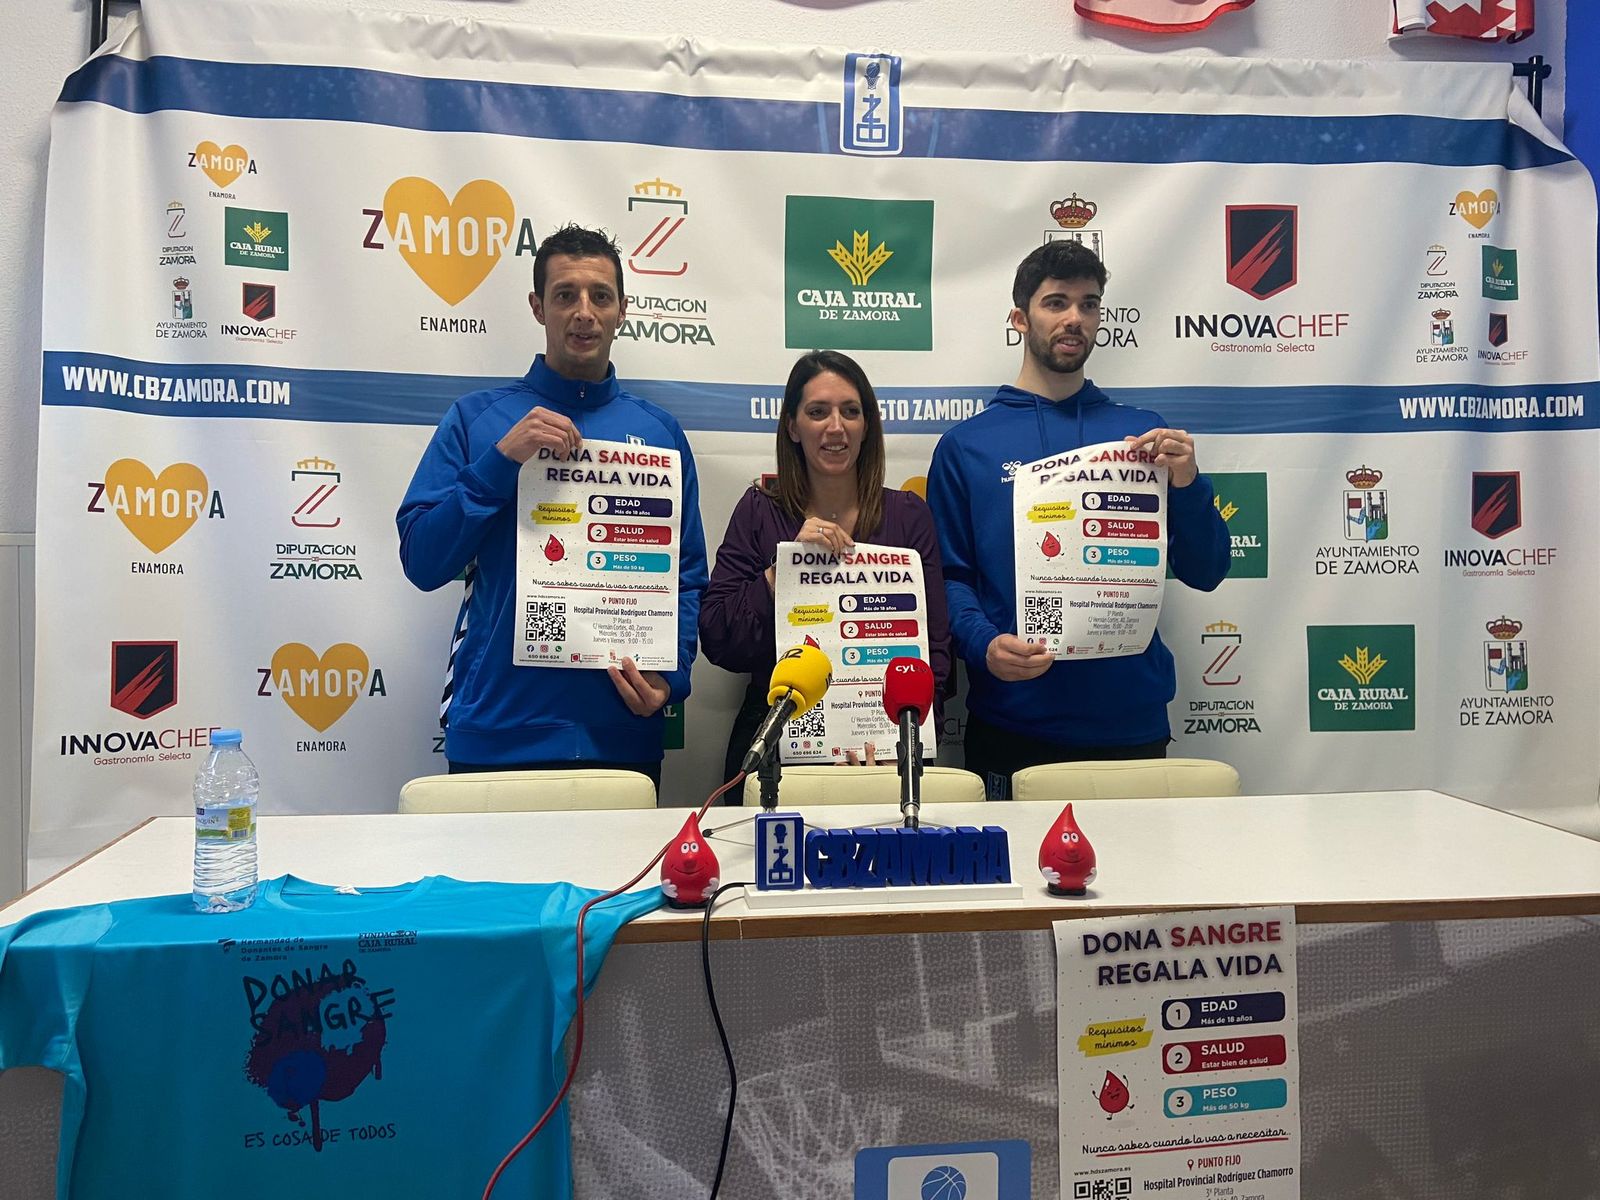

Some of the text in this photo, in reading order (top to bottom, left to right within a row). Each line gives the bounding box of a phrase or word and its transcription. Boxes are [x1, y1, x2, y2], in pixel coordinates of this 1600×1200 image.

[188, 152, 257, 174] ZAMORA
[209, 191, 236, 200] ENAMORA
[1449, 200, 1500, 215] ZAMORA
[362, 208, 538, 256] ZAMORA
[230, 242, 284, 254] CAJA RURAL
[159, 256, 196, 265] ZAMORA
[797, 289, 921, 309] CAJA RURAL
[1418, 290, 1458, 299] ZAMORA
[627, 295, 706, 313] PUTACION
[819, 309, 900, 321] DE ZAMORA
[156, 321, 207, 330] AYUNTAMIENTO
[221, 324, 297, 340] INNOVACHEF
[420, 316, 487, 333] ENAMORA
[1175, 313, 1350, 339] INNOVACHEF
[156, 329, 208, 338] DE ZAMORA
[612, 322, 715, 346] AMORA
[1276, 342, 1315, 352] Selecta
[1416, 353, 1468, 363] DE ZAMORA
[62, 366, 291, 405] WWW.CBZAMORA.COM
[751, 398, 784, 420] CLU
[912, 399, 985, 421] ZAMORA
[1400, 395, 1584, 419] WWW.CBZAMORA.COM
[599, 450, 671, 468] SANGRE
[1032, 454, 1081, 473] DONA
[547, 468, 672, 487] REGALA VIDA
[1118, 469, 1158, 483] VIDA
[87, 482, 225, 519] ZAMORA
[792, 553, 911, 565] DONA SANGRE
[1316, 545, 1420, 558] AYUNTAMIENTO
[1444, 548, 1557, 566] INNOVACHEF
[131, 562, 184, 575] ENAMORA
[270, 563, 362, 580] ZAMORA
[1316, 559, 1420, 574] DE ZAMORA
[800, 572, 913, 584] REGALA VIDA
[574, 606, 594, 614] Hospital
[595, 607, 619, 616] Provincial
[257, 668, 386, 697] ZAMORA
[1318, 687, 1408, 700] CAJA RURAL
[1352, 702, 1393, 710] ZAMORA
[1460, 696, 1554, 709] AYUNTAMIENTO
[1460, 710, 1554, 726] DE ZAMORA
[1184, 718, 1261, 734] ZAMORA
[297, 741, 346, 752] ENAMORA
[158, 752, 191, 762] Selecta
[1083, 921, 1281, 955] DONA SANGRE
[1098, 953, 1282, 986] REGALA VIDA
[243, 959, 366, 1014] DONAR
[1202, 1000, 1237, 1012] EDAD
[1176, 1009, 1180, 1020] 1
[1088, 1025, 1144, 1037] Requisitos
[1202, 1042, 1244, 1055] SALUD
[1175, 1052, 1183, 1064] 2
[1203, 1087, 1237, 1099] PESO
[1176, 1096, 1184, 1108] 3
[245, 1123, 396, 1148] ES COSA DE TODOS
[1082, 1145, 1116, 1154] Nunca
[1118, 1141, 1151, 1151] sabes
[1153, 1138, 1192, 1148] cuando
[1193, 1134, 1204, 1144] la
[1205, 1135, 1226, 1143] vas
[1198, 1155, 1241, 1168] PUNTO FIJO
[1144, 1167, 1293, 1192] Hospital Provincial Rodríguez Chamorro
